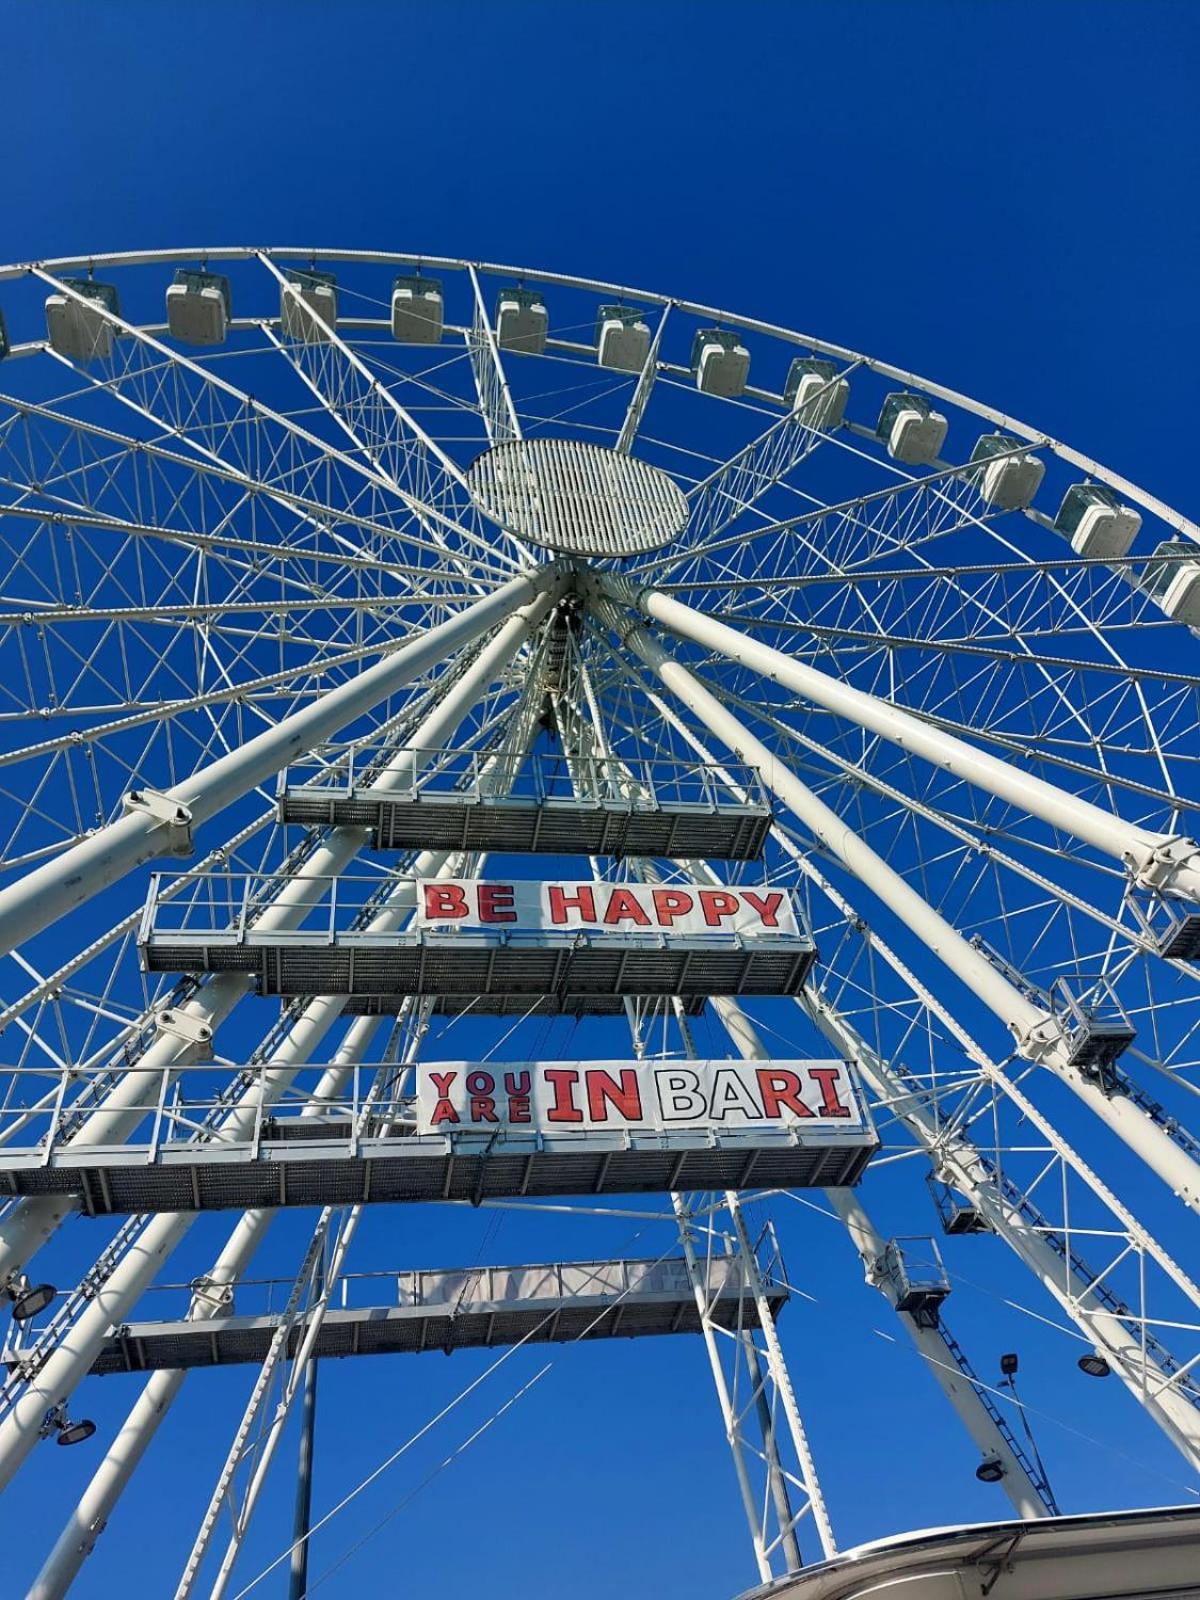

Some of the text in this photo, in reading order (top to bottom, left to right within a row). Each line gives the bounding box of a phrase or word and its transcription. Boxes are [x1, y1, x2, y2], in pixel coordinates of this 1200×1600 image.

[423, 884, 783, 926] BE HAPPY
[429, 1071, 531, 1098] YOU
[544, 1069, 851, 1121] IN BARI
[430, 1096, 531, 1125] ARE
